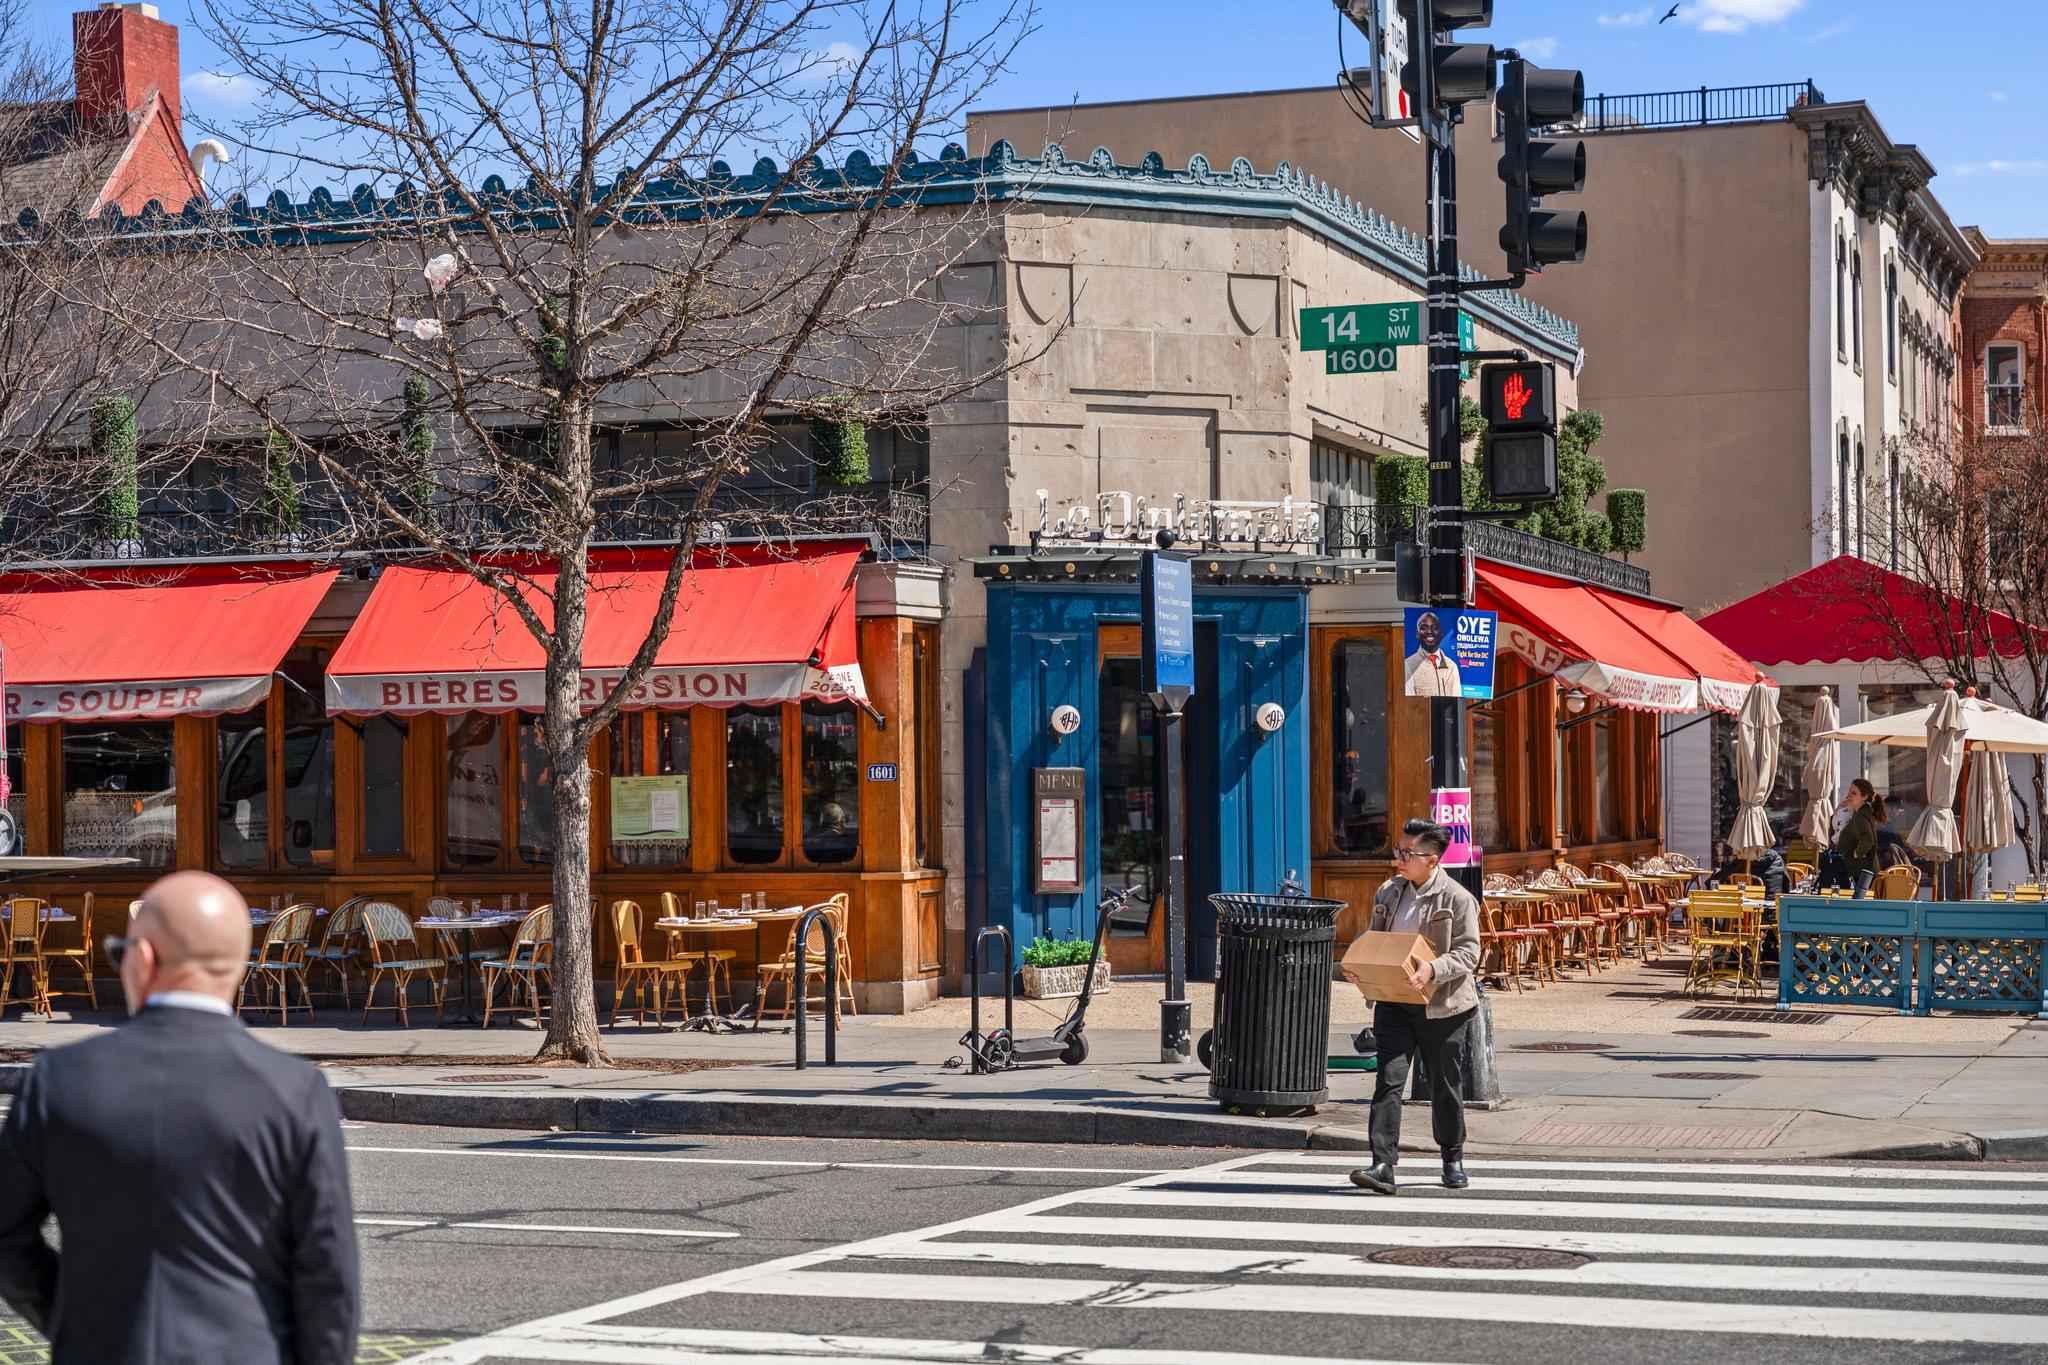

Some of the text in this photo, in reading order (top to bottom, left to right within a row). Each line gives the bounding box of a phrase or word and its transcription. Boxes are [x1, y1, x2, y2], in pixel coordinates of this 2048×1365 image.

[1389, 51, 1398, 78] ON
[1320, 307, 1410, 343] 14 ST
[1388, 325, 1411, 340] NW
[1327, 347, 1395, 372] 1600
[1036, 488, 1091, 538] Le
[1456, 634, 1490, 643] OWOLEWA
[1457, 616, 1491, 636] OYE
[57, 686, 203, 713] SOUPER
[381, 676, 518, 706] BIÈRES
[1608, 674, 1647, 701] BRASSERIE
[870, 766, 894, 779] 1601
[1039, 774, 1081, 789] MENU
